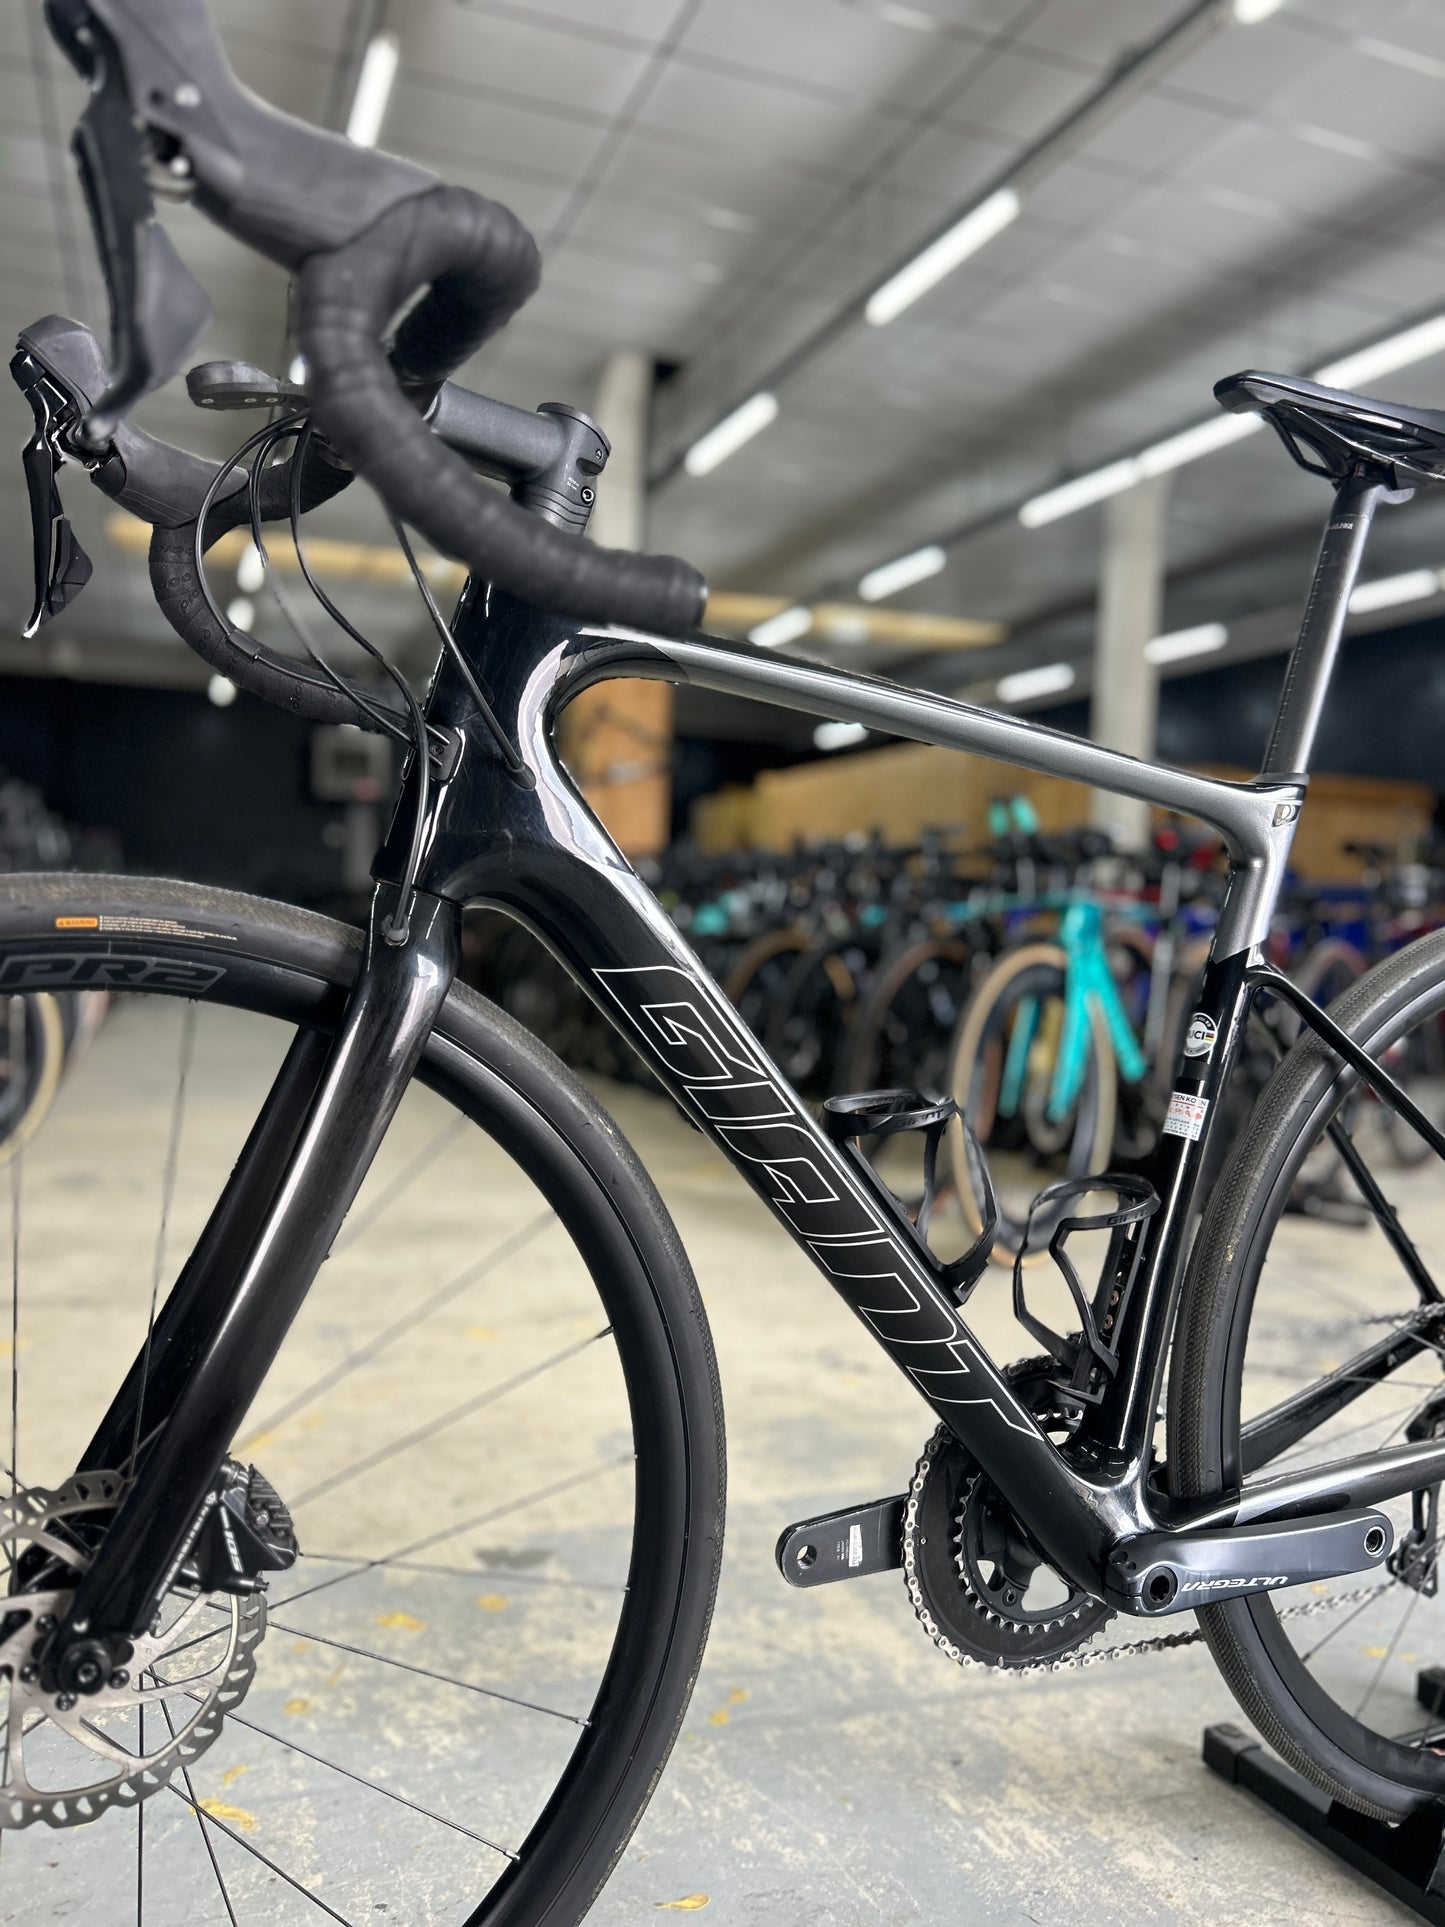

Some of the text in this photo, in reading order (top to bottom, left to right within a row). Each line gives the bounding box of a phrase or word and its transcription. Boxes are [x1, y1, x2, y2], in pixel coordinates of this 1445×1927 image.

[0, 955, 227, 992] PR2
[896, 1109, 944, 1127] INT
[593, 965, 1044, 1441] GIANT
[1182, 1575, 1289, 1592] ULTEGRA
